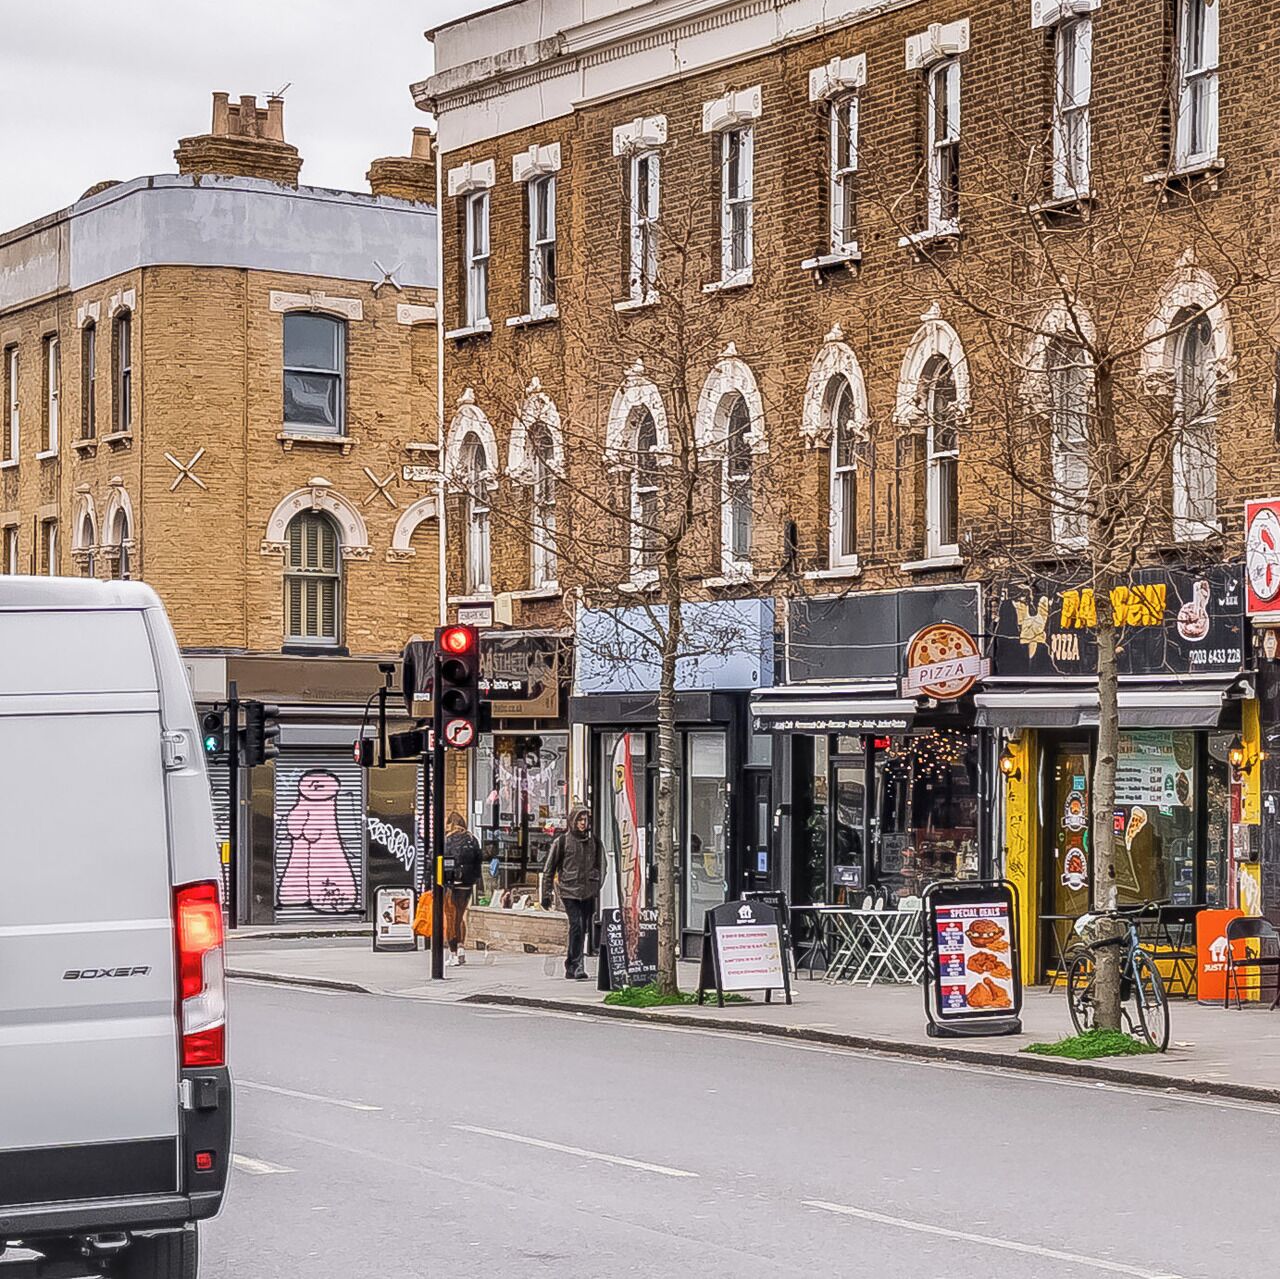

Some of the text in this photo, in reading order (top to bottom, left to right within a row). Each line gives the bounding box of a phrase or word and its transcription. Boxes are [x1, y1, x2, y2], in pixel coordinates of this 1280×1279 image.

[919, 662, 965, 681] PIZZA
[950, 907, 1001, 918] SPECIAL DEALS
[63, 966, 151, 980] BOXER
[1204, 963, 1224, 972] JUST
